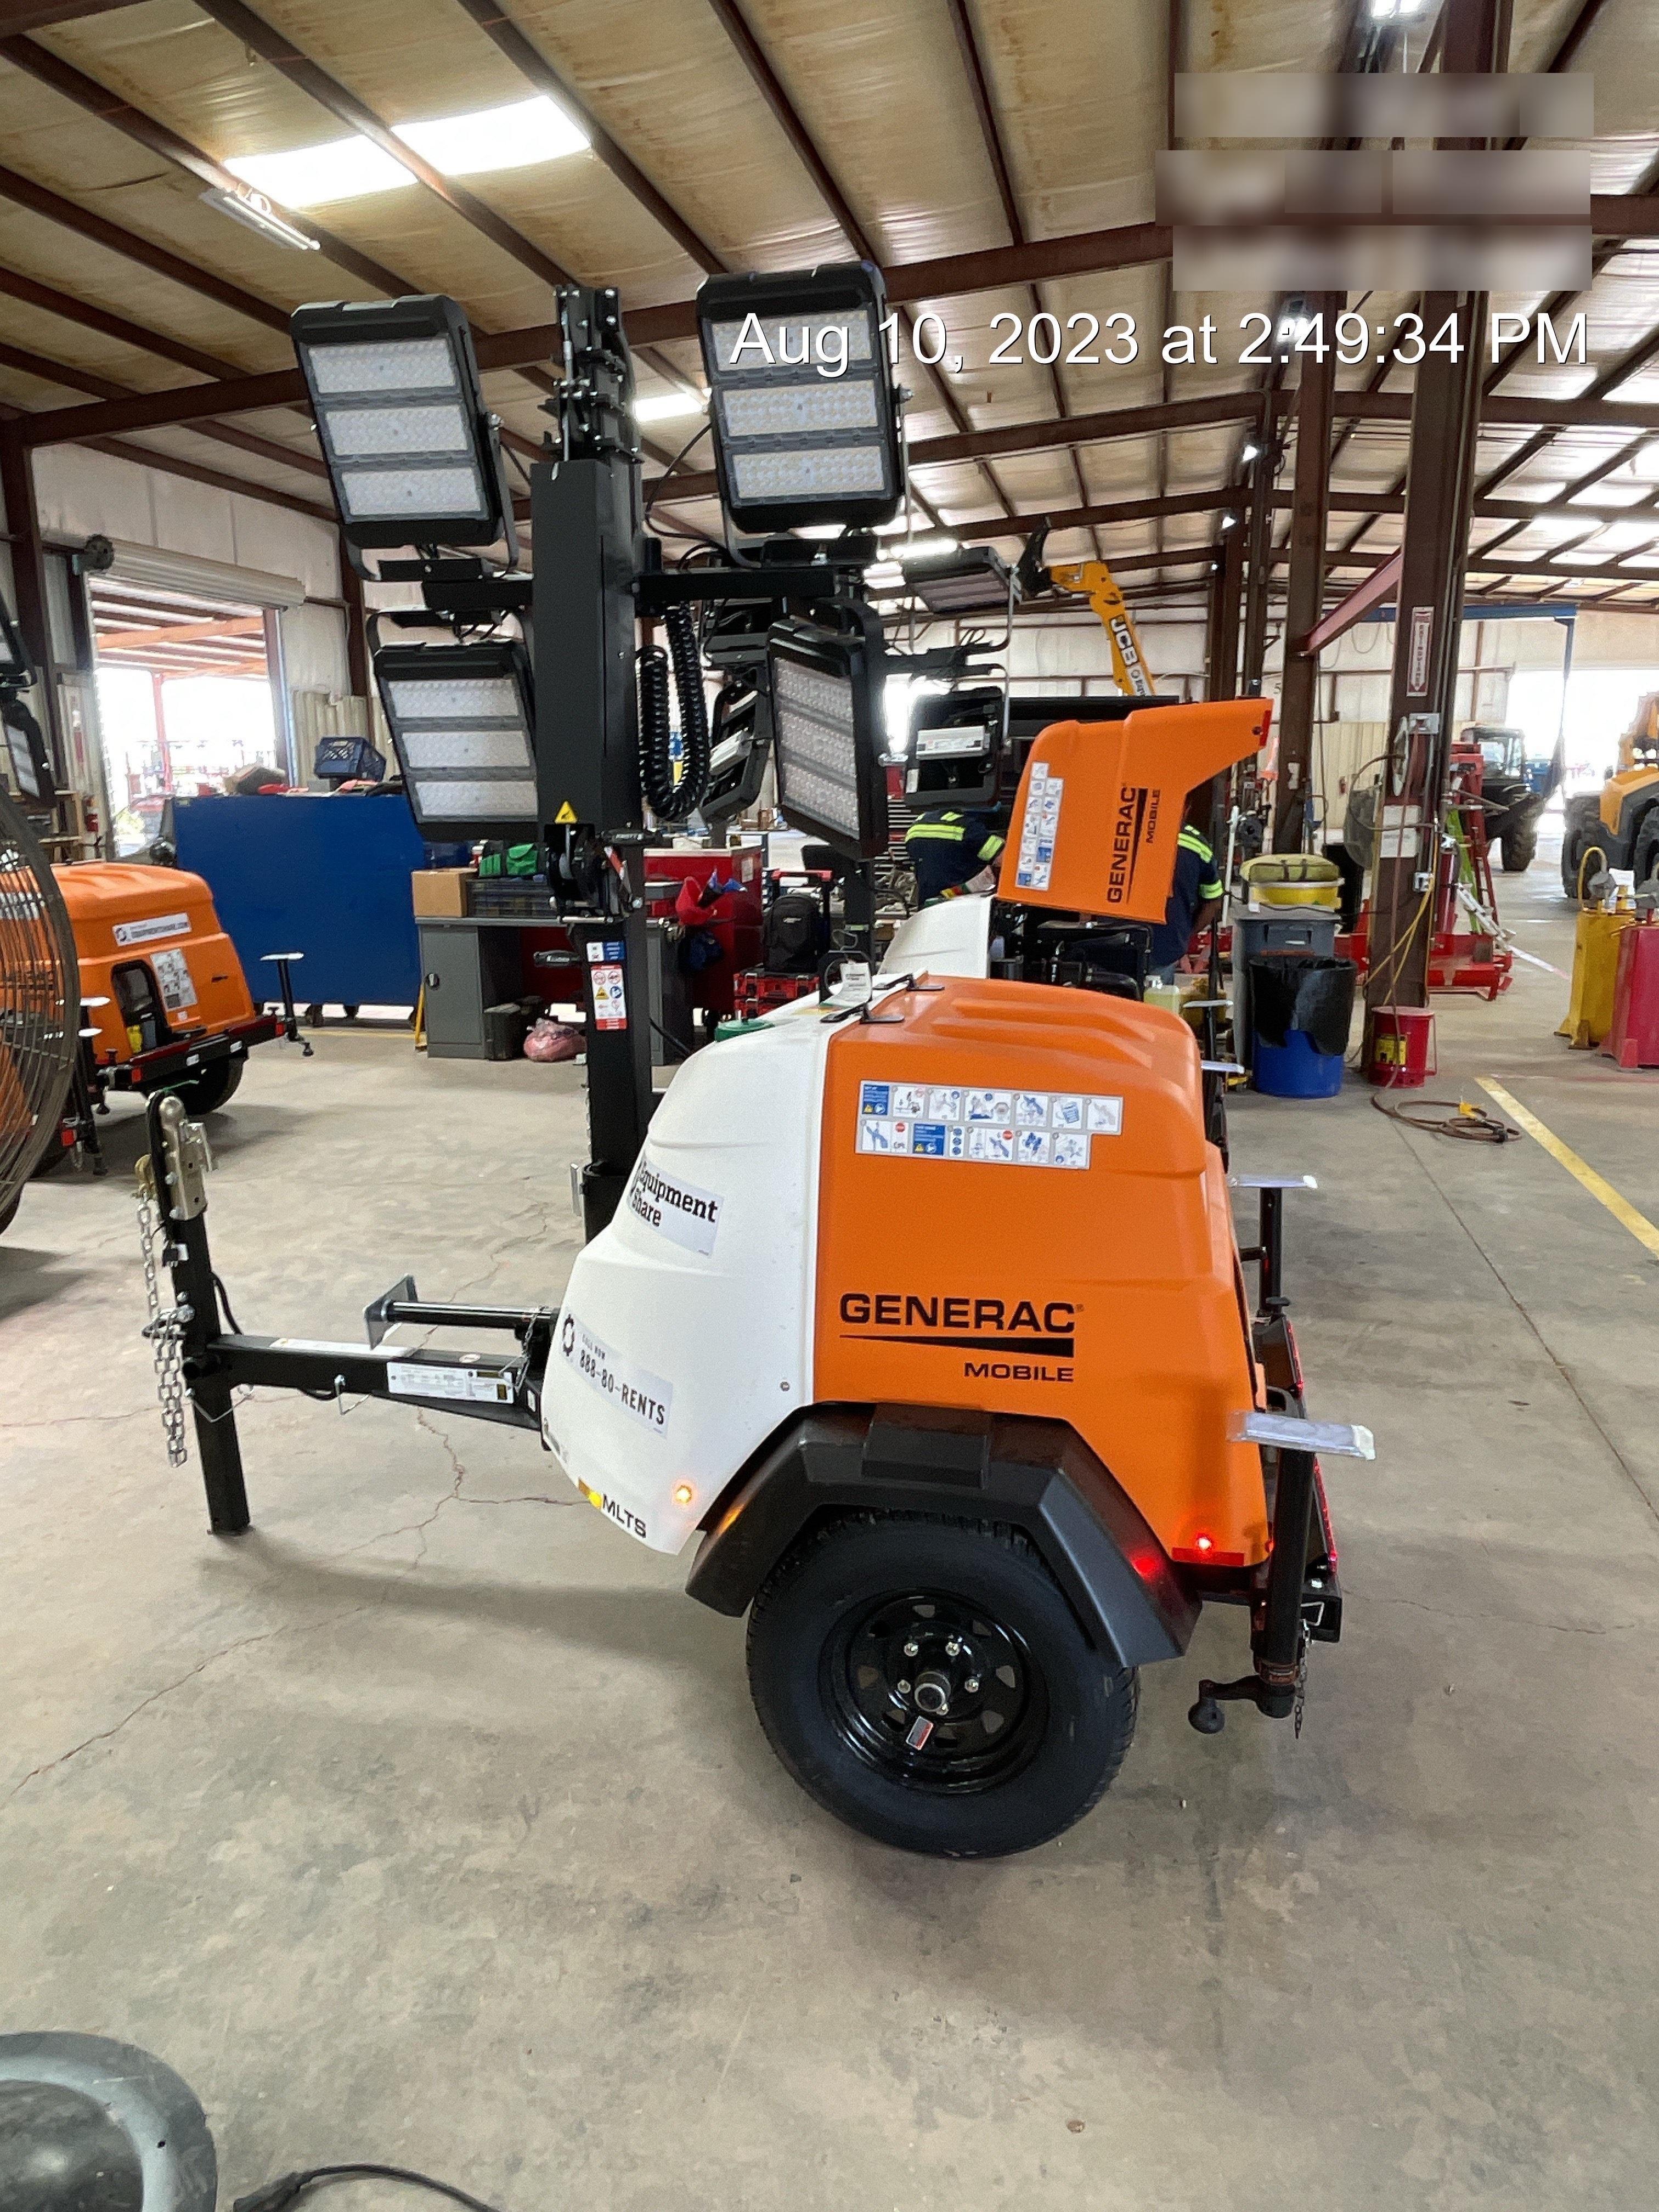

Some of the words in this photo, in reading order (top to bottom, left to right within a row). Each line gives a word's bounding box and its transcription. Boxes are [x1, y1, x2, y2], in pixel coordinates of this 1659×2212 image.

[1110, 617, 1139, 667] JCB
[1146, 789, 1160, 844] MOBILE
[1107, 786, 1136, 904] GENERAC
[839, 1293, 1075, 1333] GENERAC
[580, 1350, 665, 1425] 888-80-RENTS
[964, 1362, 1074, 1382] MOBILE
[603, 1494, 647, 1538] MLTS
